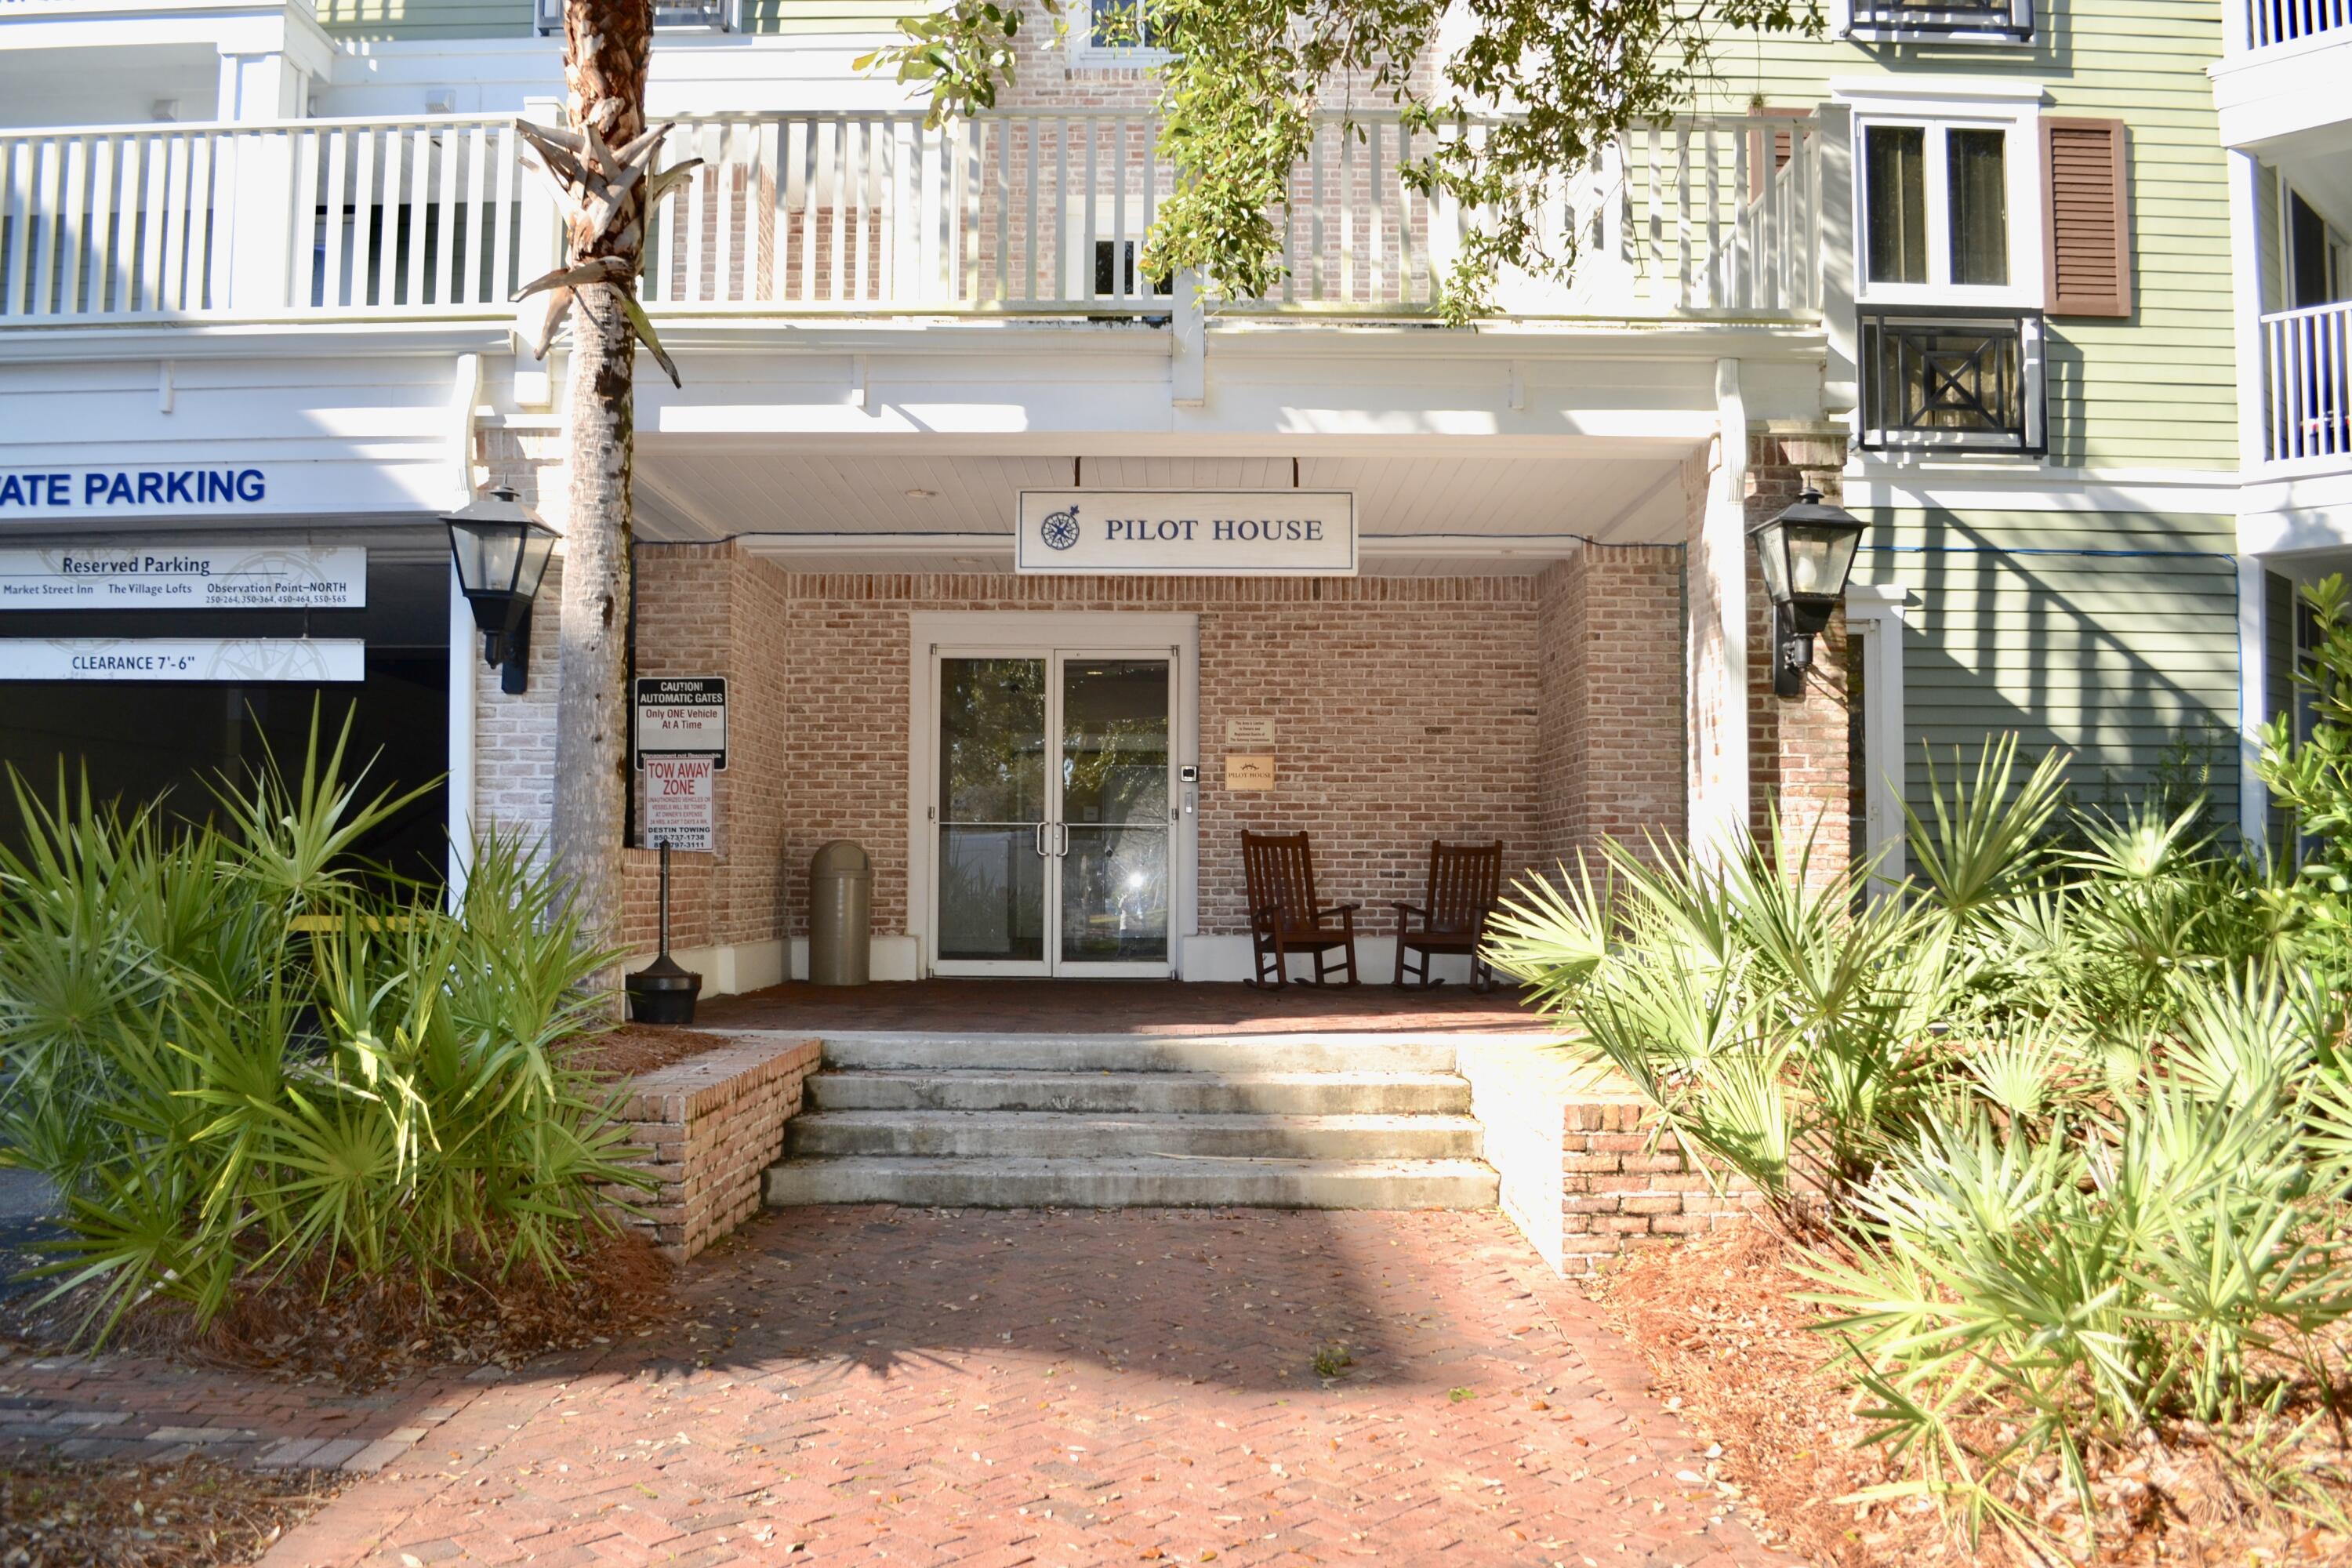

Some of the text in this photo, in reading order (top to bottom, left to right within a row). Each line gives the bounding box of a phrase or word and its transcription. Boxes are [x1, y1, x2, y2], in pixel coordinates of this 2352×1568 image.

[0, 469, 266, 506] ATE PARKING
[1105, 520, 1323, 541] PILOT HOUSE
[63, 556, 210, 575] Reserved Parking
[3, 584, 93, 594] Market Street Inn
[108, 583, 192, 596] The Village Lofts
[207, 583, 271, 593] Observation
[72, 656, 153, 670] CLEARANCE
[660, 681, 703, 691] CAUTION!
[640, 693, 723, 703] AUTOMATIC GATES
[646, 709, 717, 720] Only ONE Vehicle
[662, 720, 702, 729] At A Time
[648, 763, 710, 779] TOW AWAY
[663, 779, 695, 795] ZONE
